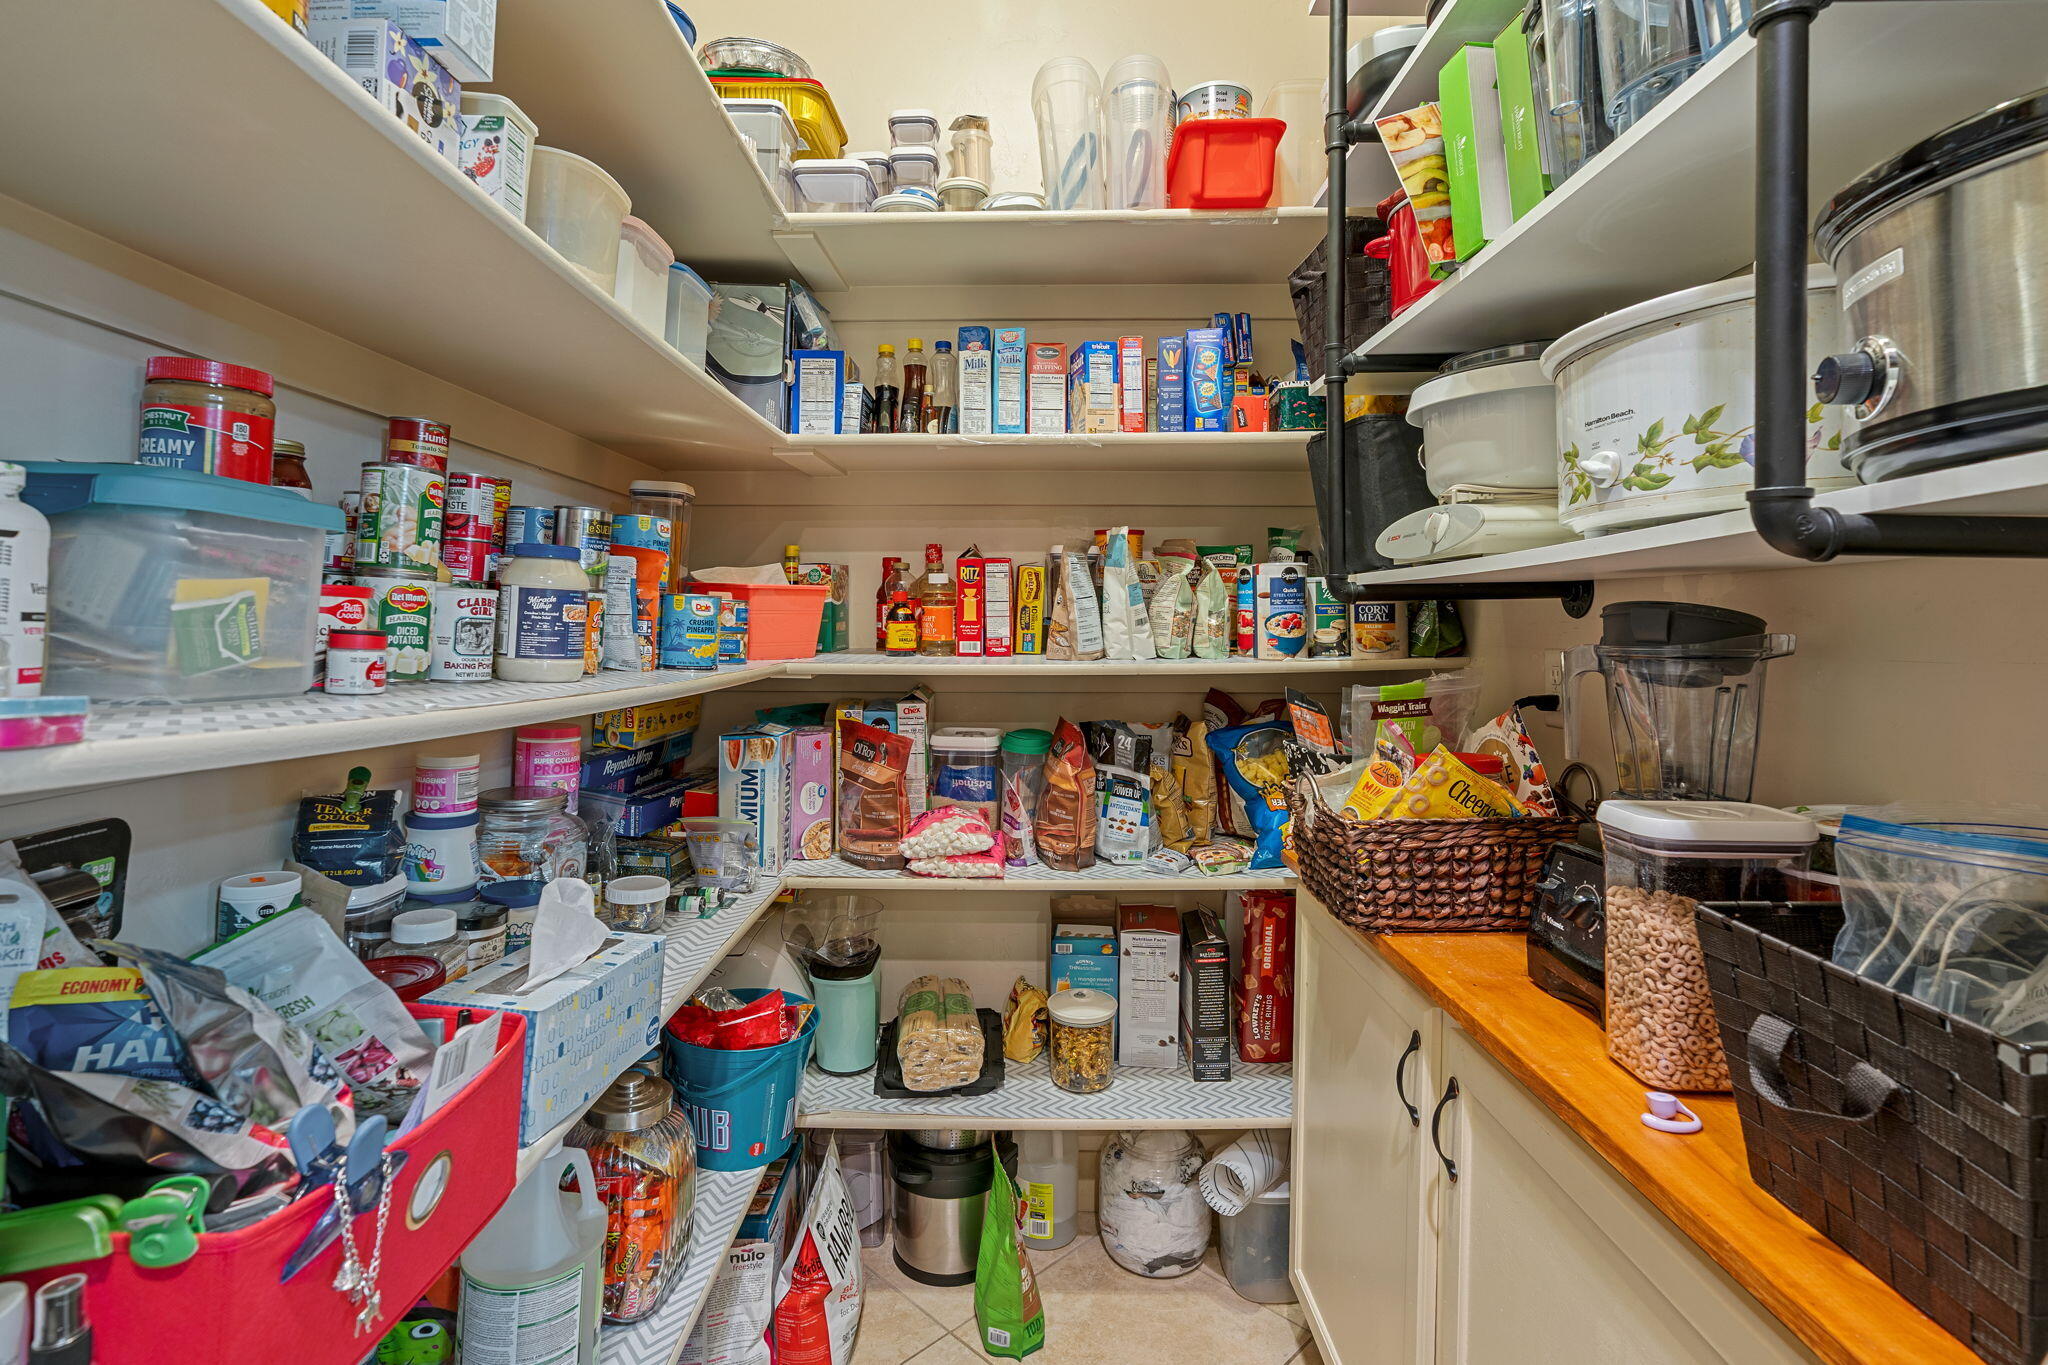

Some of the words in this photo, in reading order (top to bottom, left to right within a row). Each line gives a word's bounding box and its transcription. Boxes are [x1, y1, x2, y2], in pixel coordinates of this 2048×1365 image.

[964, 357, 987, 370] Milk
[999, 354, 1022, 364] Milk
[144, 411, 182, 421] CHESTNUT
[1584, 414, 1611, 428] Hamilton
[140, 437, 195, 456] CREAMY
[960, 566, 980, 580] RITZ
[527, 595, 557, 604] Miracle
[531, 601, 553, 611] Whip
[695, 603, 712, 611] Dole
[1358, 605, 1389, 614] CORN
[388, 615, 425, 623] HARVEST
[1358, 613, 1389, 622] MEAL
[396, 626, 419, 635] DICED
[388, 635, 424, 645] POTATOES
[444, 662, 476, 670] BAKING
[903, 707, 921, 715] Chex
[1407, 702, 1427, 710] Train
[1118, 734, 1132, 751] 24
[603, 754, 637, 776] Reynolds
[636, 750, 654, 767] Wrap
[952, 778, 993, 790] Basmati
[1096, 781, 1105, 790] UP
[1113, 785, 1134, 797] POWER
[315, 804, 373, 815] TENR
[317, 814, 366, 823] QUICK
[259, 907, 275, 916] STEM
[1263, 924, 1273, 969] ORIGINAL
[60, 978, 131, 995] ECONOMY
[1265, 994, 1273, 1017] RINDS
[1250, 993, 1263, 1040] LOWREY'S
[614, 1241, 638, 1277] Reese's
[732, 1260, 763, 1272] freestyle
